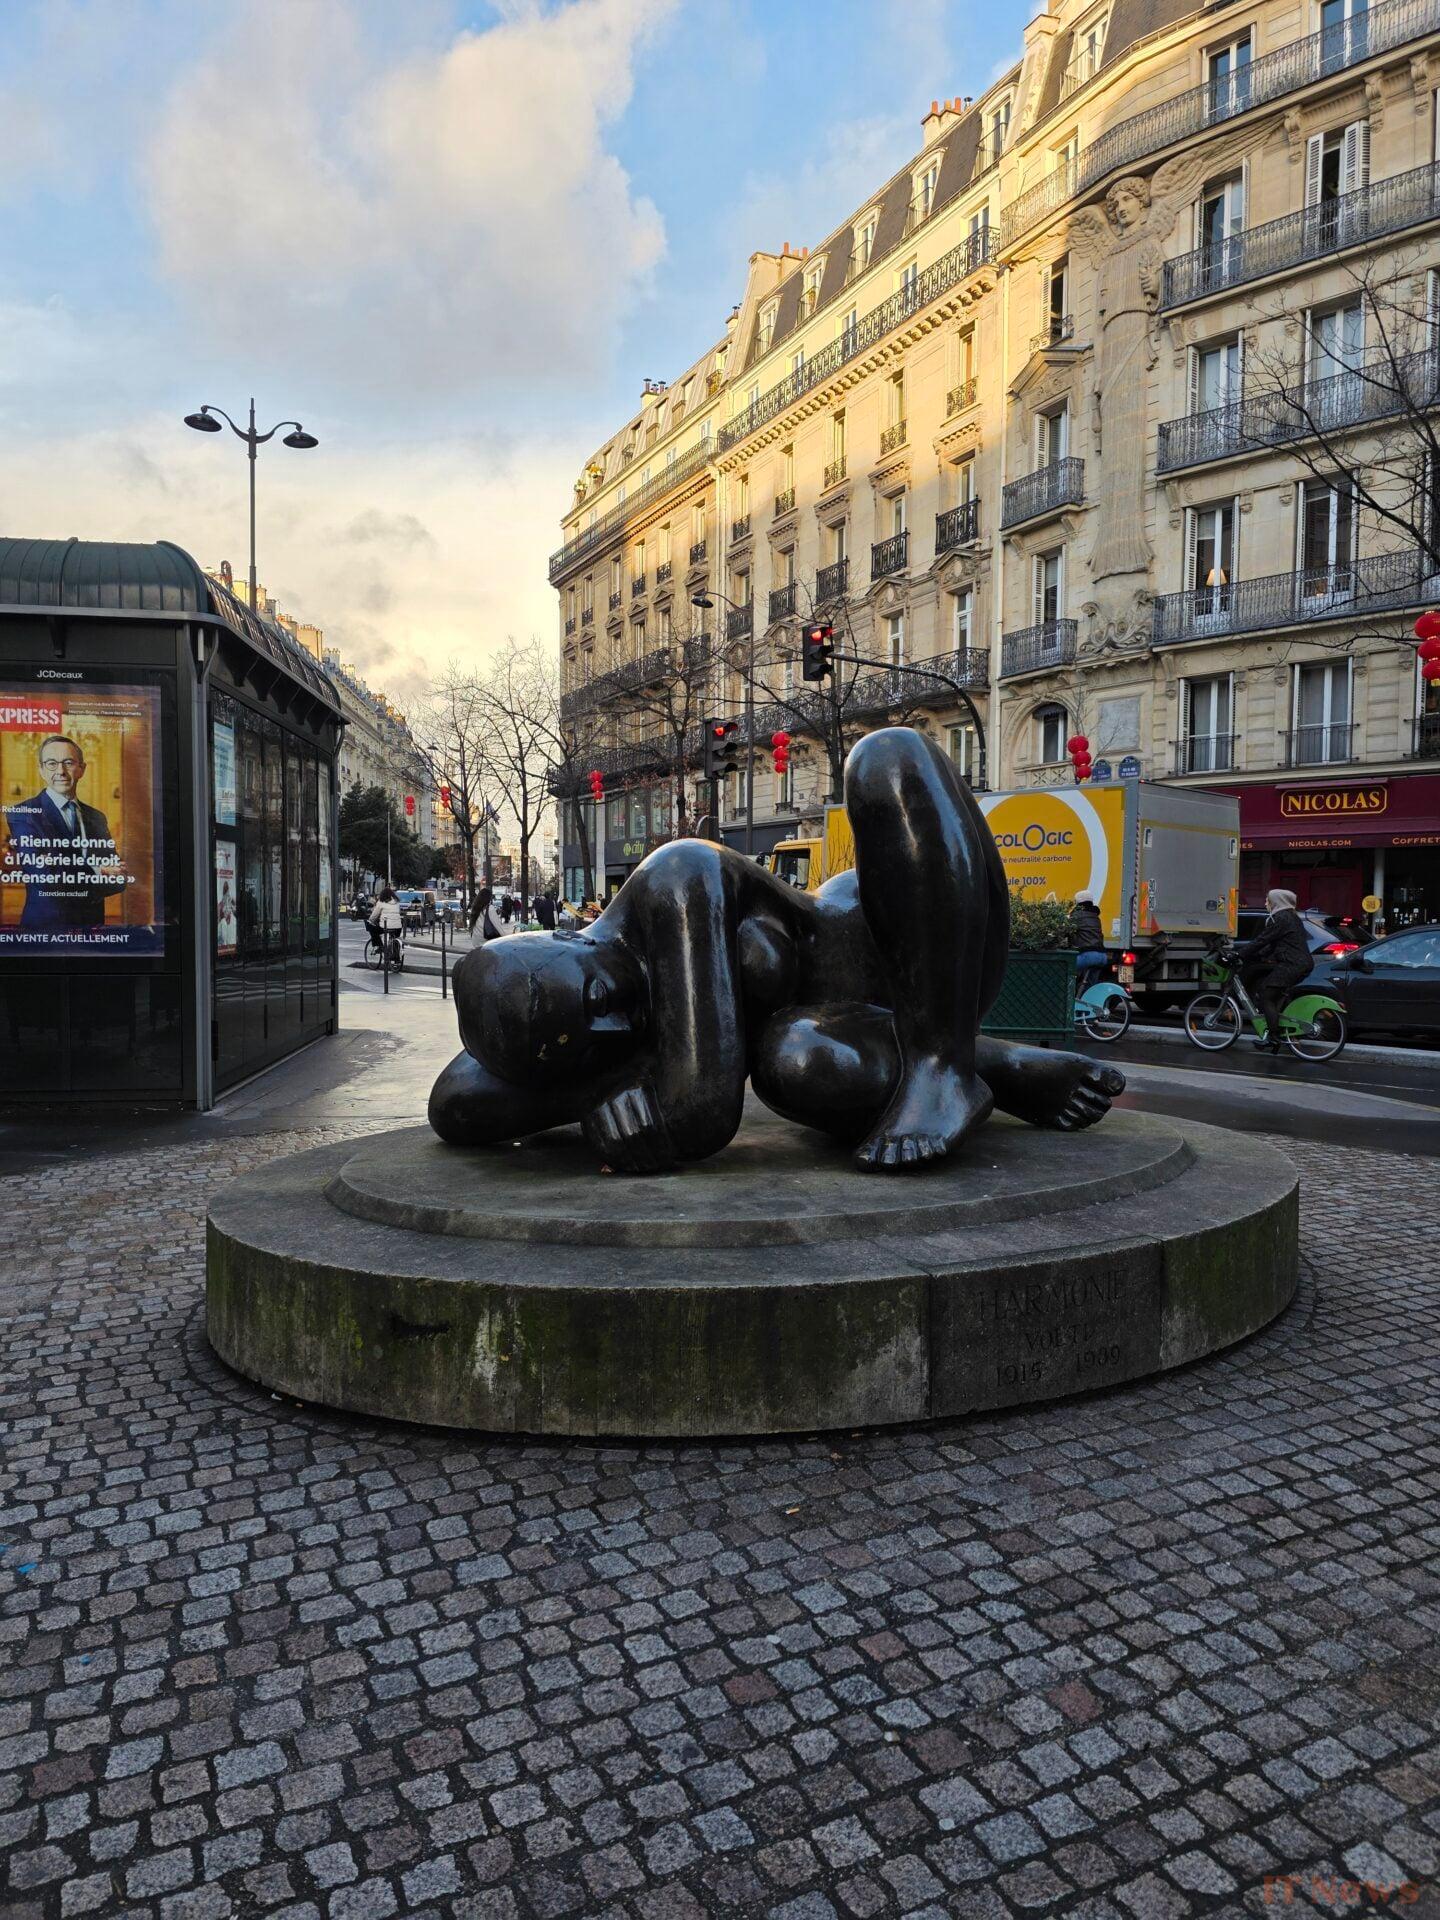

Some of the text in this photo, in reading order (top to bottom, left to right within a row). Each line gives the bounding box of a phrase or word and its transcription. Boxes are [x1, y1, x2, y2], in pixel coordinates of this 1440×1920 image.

[36, 670, 83, 679] JCDecaux
[1287, 791, 1380, 812] NICOLAS
[2, 805, 43, 814] Retailleau
[20, 835, 51, 848] Rien
[52, 838, 70, 848] ne
[71, 836, 116, 849] donne
[1288, 839, 1352, 848] NICOLAS.COM
[4, 852, 121, 868] à l'Algérie le droit
[1009, 855, 1041, 863] neutralité
[63, 871, 75, 884] la
[77, 871, 125, 884] France
[1022, 876, 1047, 885] 100%
[0, 934, 130, 943] EN VENTE ACTUELLEMENT
[979, 1269, 1128, 1321] HARMONIE
[996, 1360, 1044, 1387] 1915
